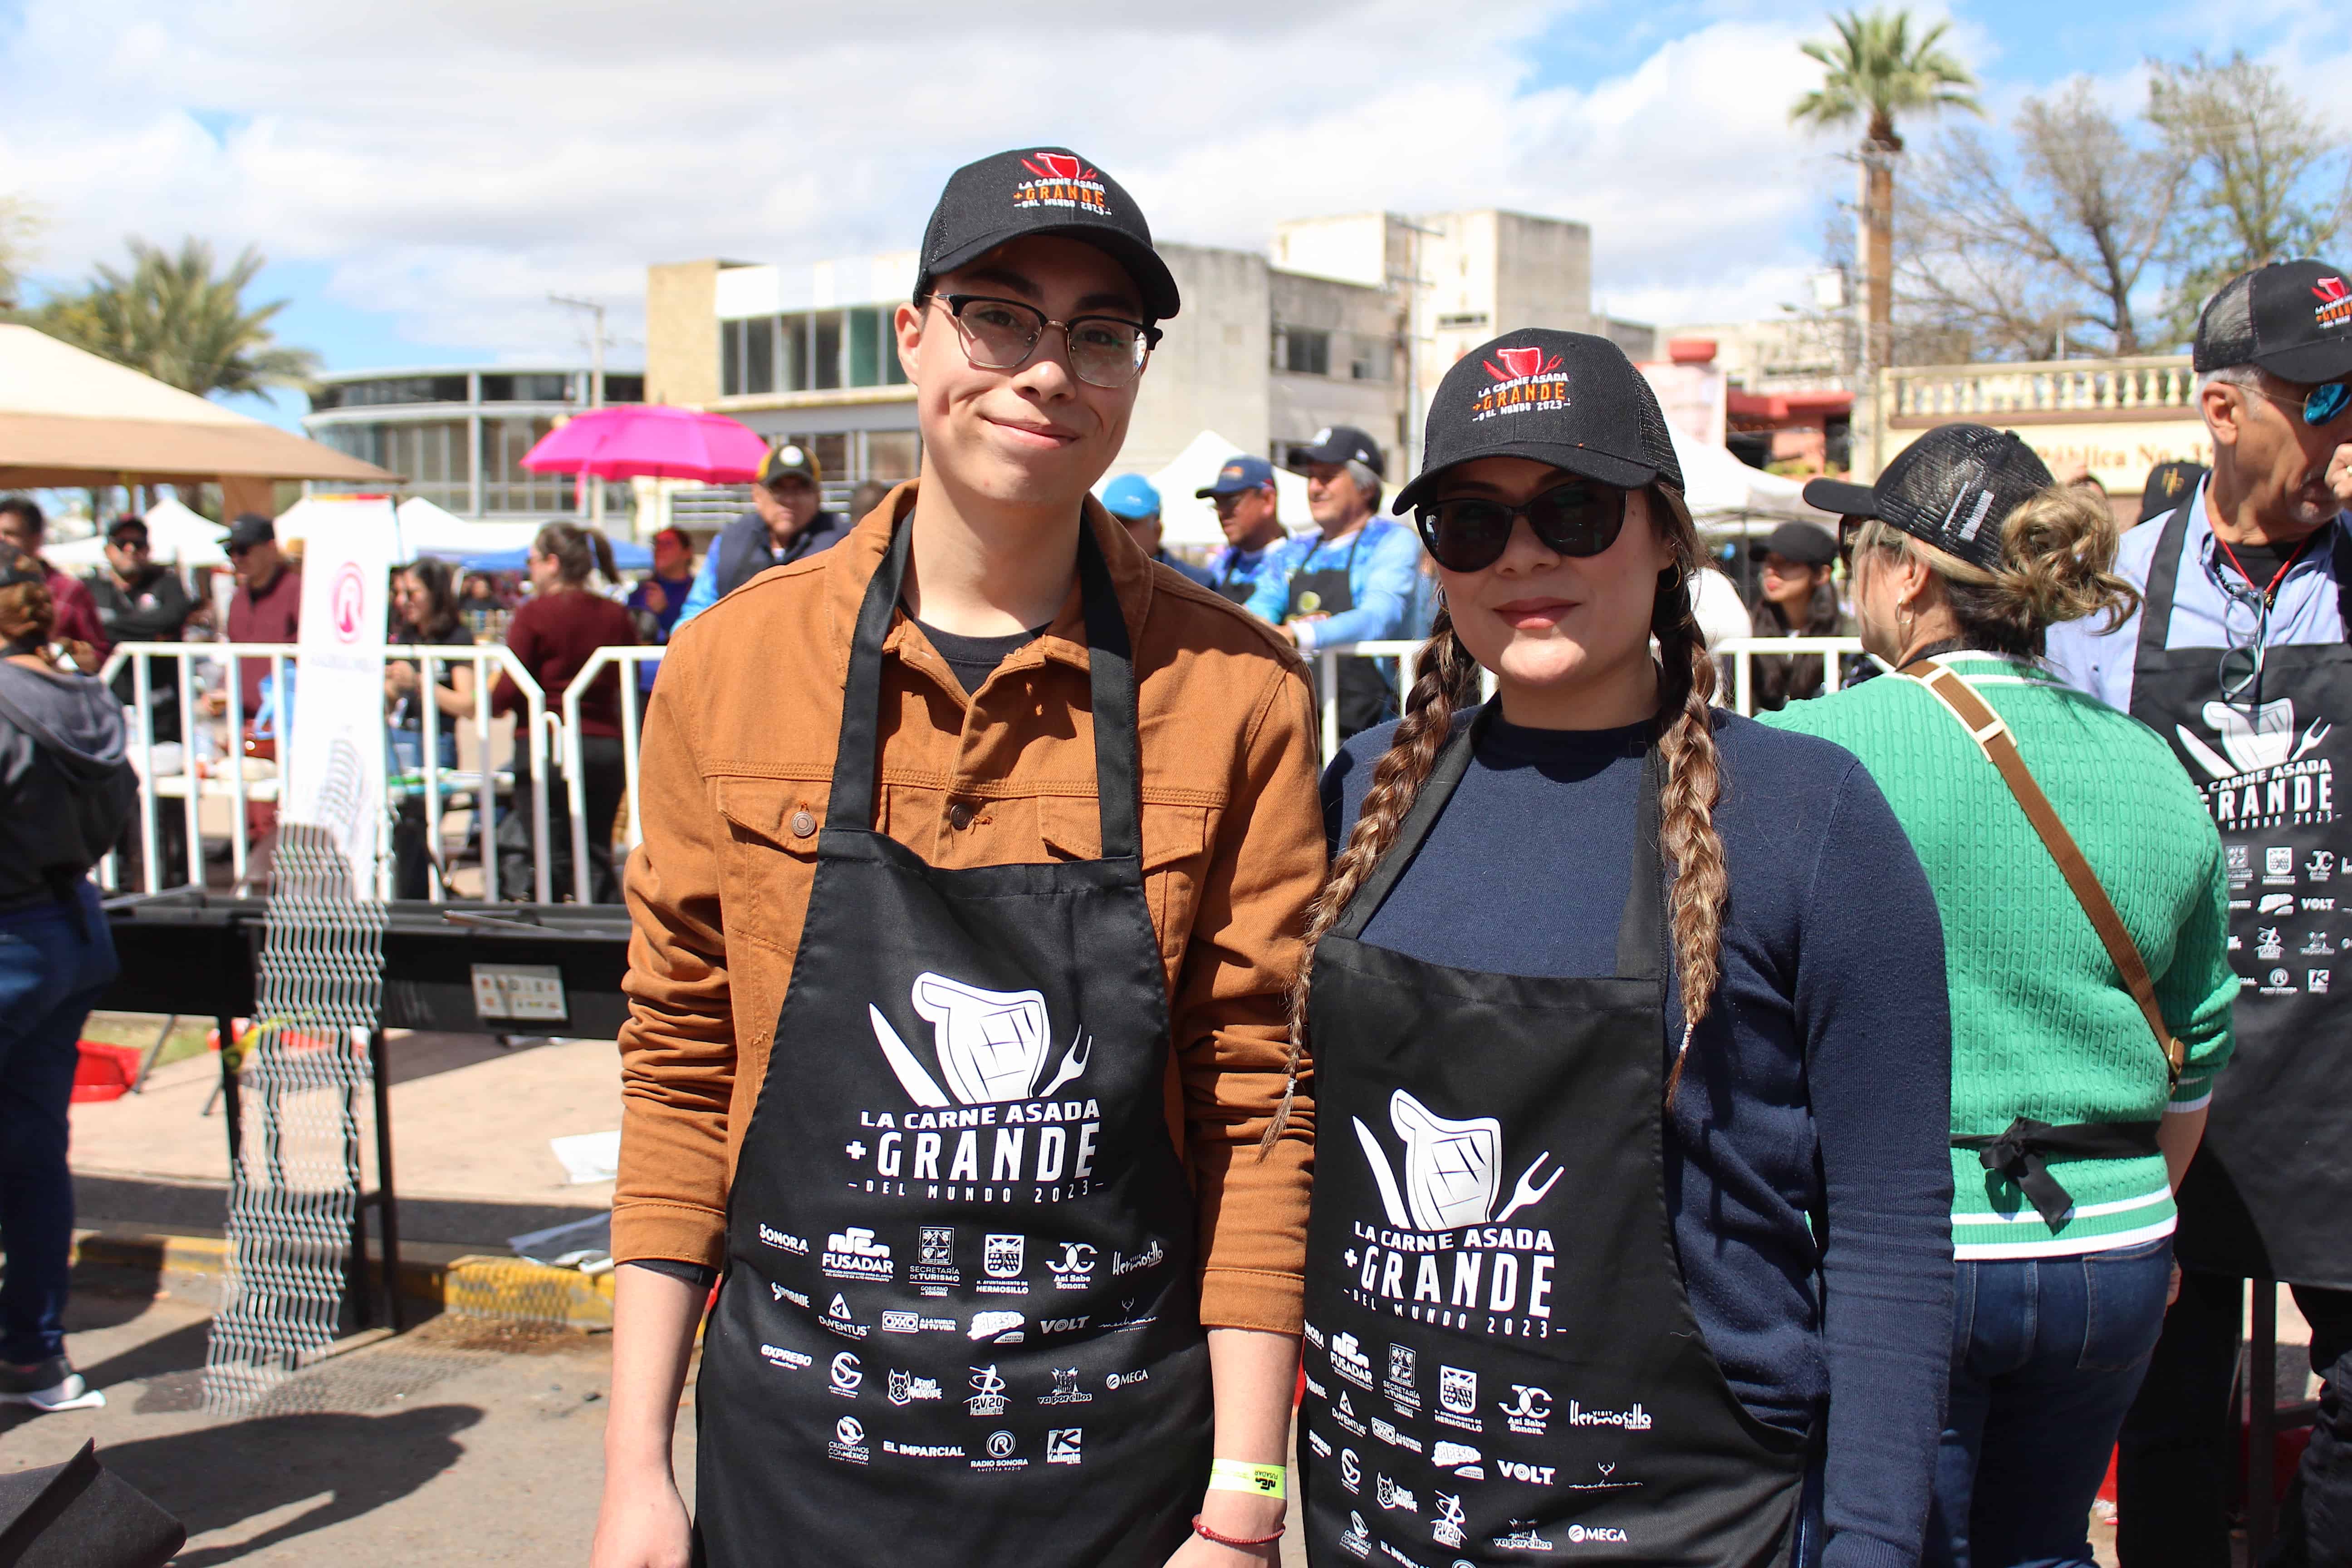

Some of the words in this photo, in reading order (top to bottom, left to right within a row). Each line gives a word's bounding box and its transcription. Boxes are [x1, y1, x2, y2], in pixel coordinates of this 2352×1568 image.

[1018, 181, 1034, 190] LA
[1035, 177, 1072, 186] CARNE
[1073, 179, 1106, 193] ASADA
[1044, 198, 1075, 207] MUNDO
[1478, 387, 1491, 398] LA
[1493, 376, 1530, 393] CARNE
[1531, 372, 1569, 384] ASADA
[1500, 402, 1531, 415] MUNDO
[2208, 769, 2268, 794] CARNE
[2271, 758, 2332, 780] ASADA
[2228, 815, 2282, 832] MUNDO
[2301, 898, 2335, 911] VOLT
[860, 1110, 895, 1128] LA
[904, 1105, 997, 1129] CARNE
[1004, 1098, 1101, 1124] ASADA
[928, 1185, 1011, 1203] MUNDO
[759, 1223, 810, 1253] SONORA
[1354, 1220, 1377, 1243] LA
[1381, 1230, 1454, 1252] CARNE
[1463, 1228, 1555, 1252] ASADA
[822, 1252, 894, 1274] FUSADAR
[1112, 1240, 1163, 1276] Hermosillo
[910, 1265, 960, 1275] SECRETARÍA
[976, 1285, 1029, 1294] HERMOSILLO
[884, 1316, 916, 1328] OXXO
[1040, 1316, 1090, 1334] VOLT
[1394, 1303, 1467, 1330] MUNDO
[1330, 1350, 1373, 1385] FUSADAR
[914, 1377, 937, 1389] PERRO
[1120, 1368, 1149, 1386] MEGA
[1037, 1396, 1051, 1405] va
[1051, 1396, 1069, 1405] por
[1069, 1392, 1092, 1402] ellos
[1382, 1380, 1421, 1400] SECRETARÍA
[1569, 1399, 1652, 1426] Hermosillo
[1373, 1422, 1394, 1440] OXXO
[1435, 1414, 1483, 1433] HERMOSILLO
[828, 1441, 870, 1454] CIUDADANOS
[883, 1440, 898, 1454] EL
[900, 1444, 965, 1457] IMPARCIAL
[970, 1460, 995, 1468] RADIO
[996, 1458, 1029, 1467] SONORA
[1254, 1470, 1278, 1480] FUSADAR
[1497, 1459, 1555, 1485] VOLT
[1585, 1527, 1628, 1542] MEGA
[1380, 1539, 1391, 1554] EL
[1493, 1538, 1508, 1547] va
[1509, 1539, 1528, 1549] por
[1528, 1538, 1553, 1550] ellos
